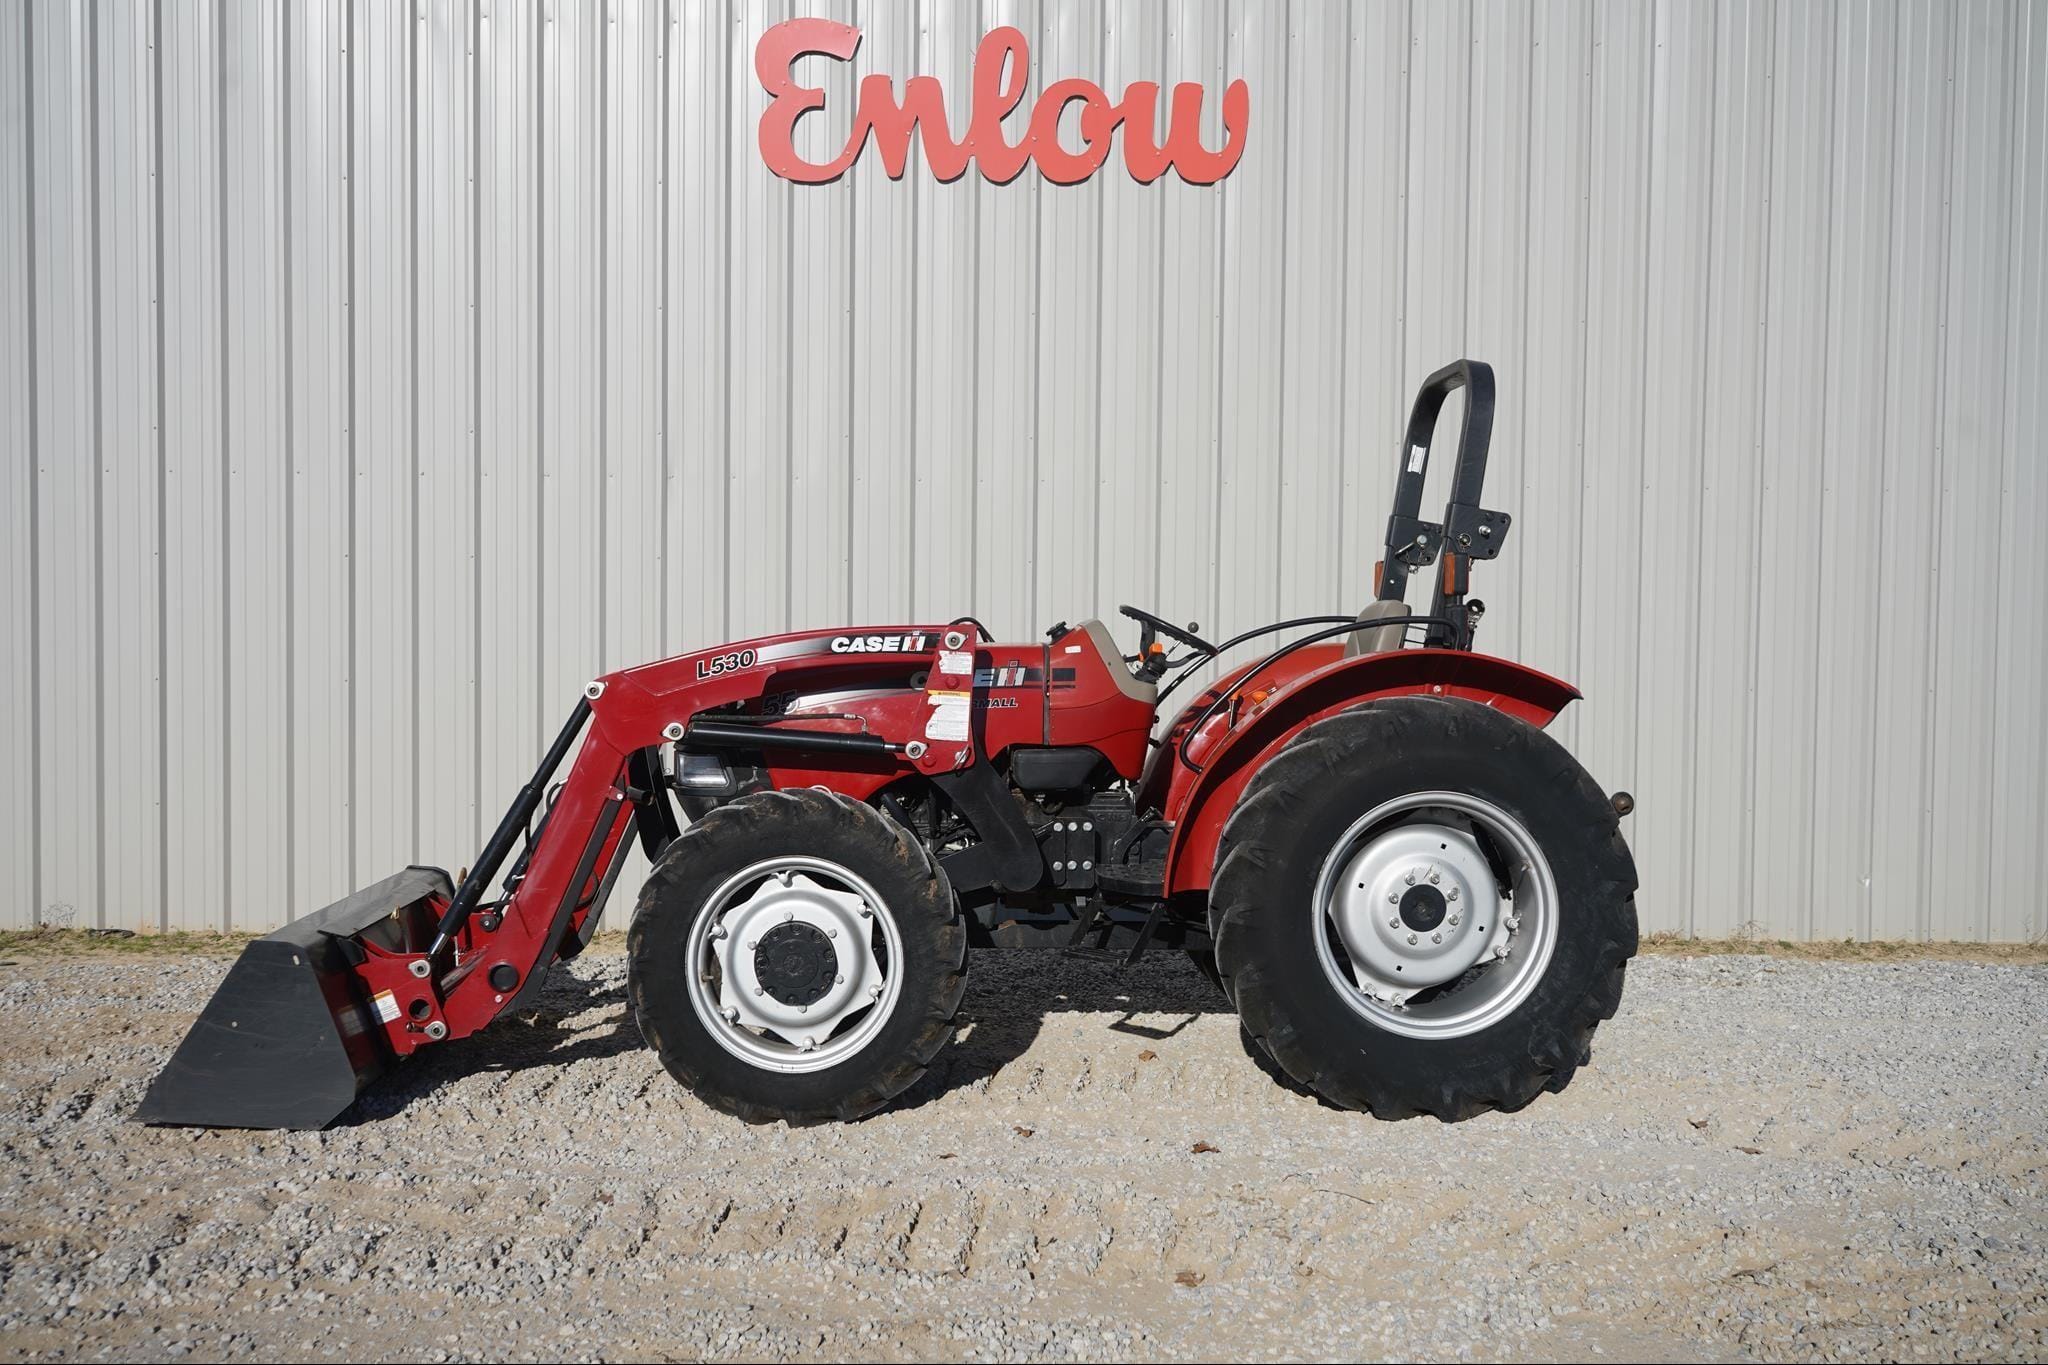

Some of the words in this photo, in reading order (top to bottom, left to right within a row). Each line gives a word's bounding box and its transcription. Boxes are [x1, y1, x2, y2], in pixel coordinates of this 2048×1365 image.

[755, 18, 1250, 184] Enlow
[830, 636, 899, 653] CASE
[697, 649, 755, 681] L530
